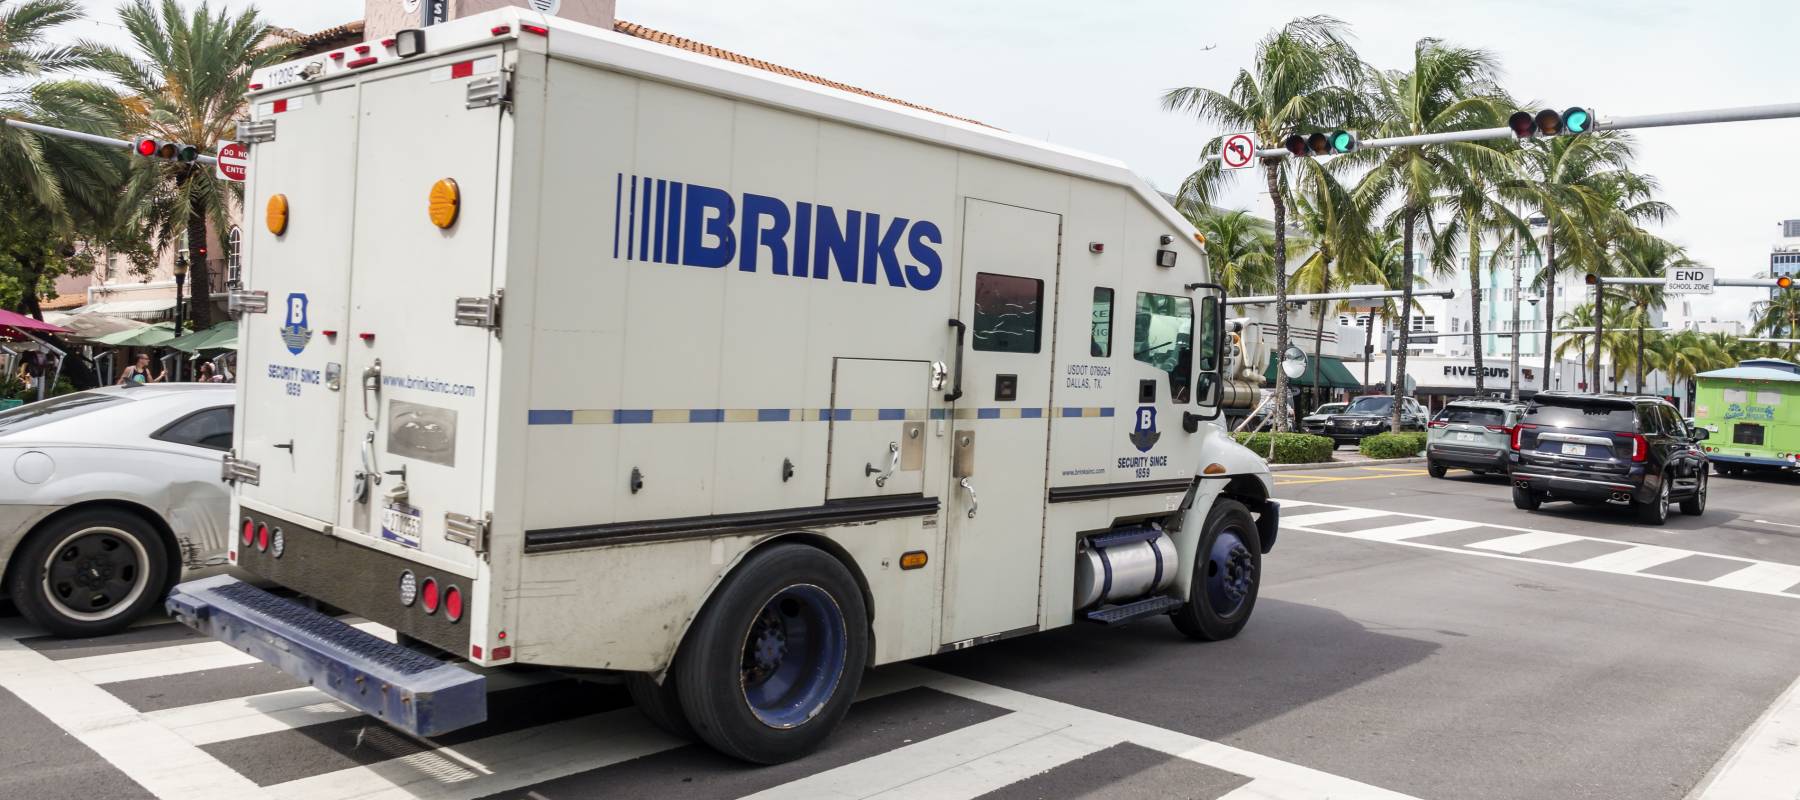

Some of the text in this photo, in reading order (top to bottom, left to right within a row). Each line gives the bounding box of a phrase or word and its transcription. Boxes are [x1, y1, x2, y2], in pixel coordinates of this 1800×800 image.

[223, 148, 249, 158] DO NO
[226, 165, 246, 175] ENTE
[682, 183, 943, 291] BRINKS
[1675, 271, 1704, 281] END
[1693, 283, 1710, 291] ZONE
[268, 364, 320, 385] SECURITY SINCE
[1067, 364, 1089, 376] USDOT
[1443, 365, 1477, 377] FIVE
[1482, 367, 1509, 378] GUYS
[286, 381, 301, 397] 1859
[382, 373, 475, 397] www.brinksinc.com
[1117, 455, 1168, 469] SECURITY SINCE
[1135, 467, 1151, 478] 1859
